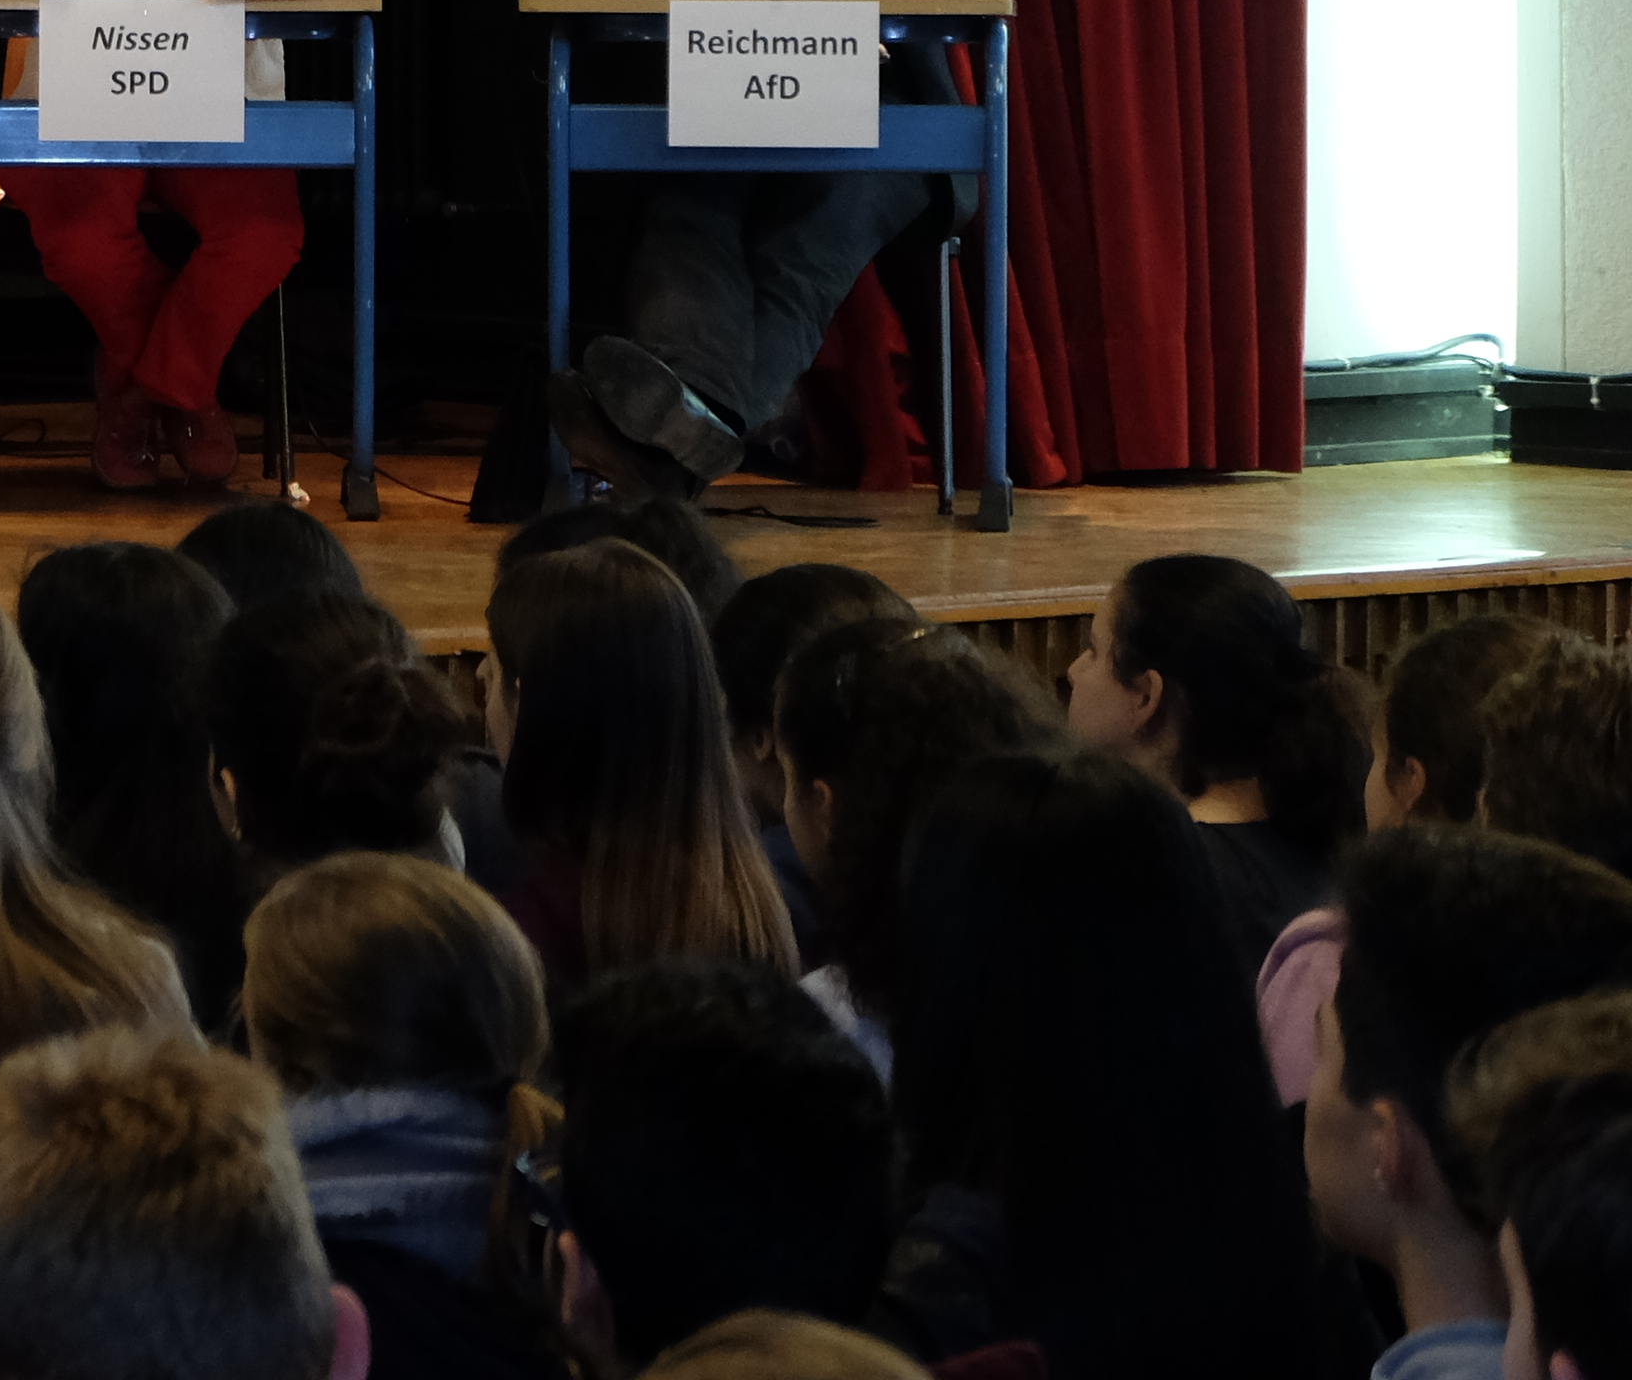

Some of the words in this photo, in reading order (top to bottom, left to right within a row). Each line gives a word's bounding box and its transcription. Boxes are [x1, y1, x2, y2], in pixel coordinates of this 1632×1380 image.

[92, 25, 189, 51] Nissen
[687, 28, 858, 56] Reichmann
[110, 70, 169, 95] SPD
[743, 74, 801, 100] AfD
